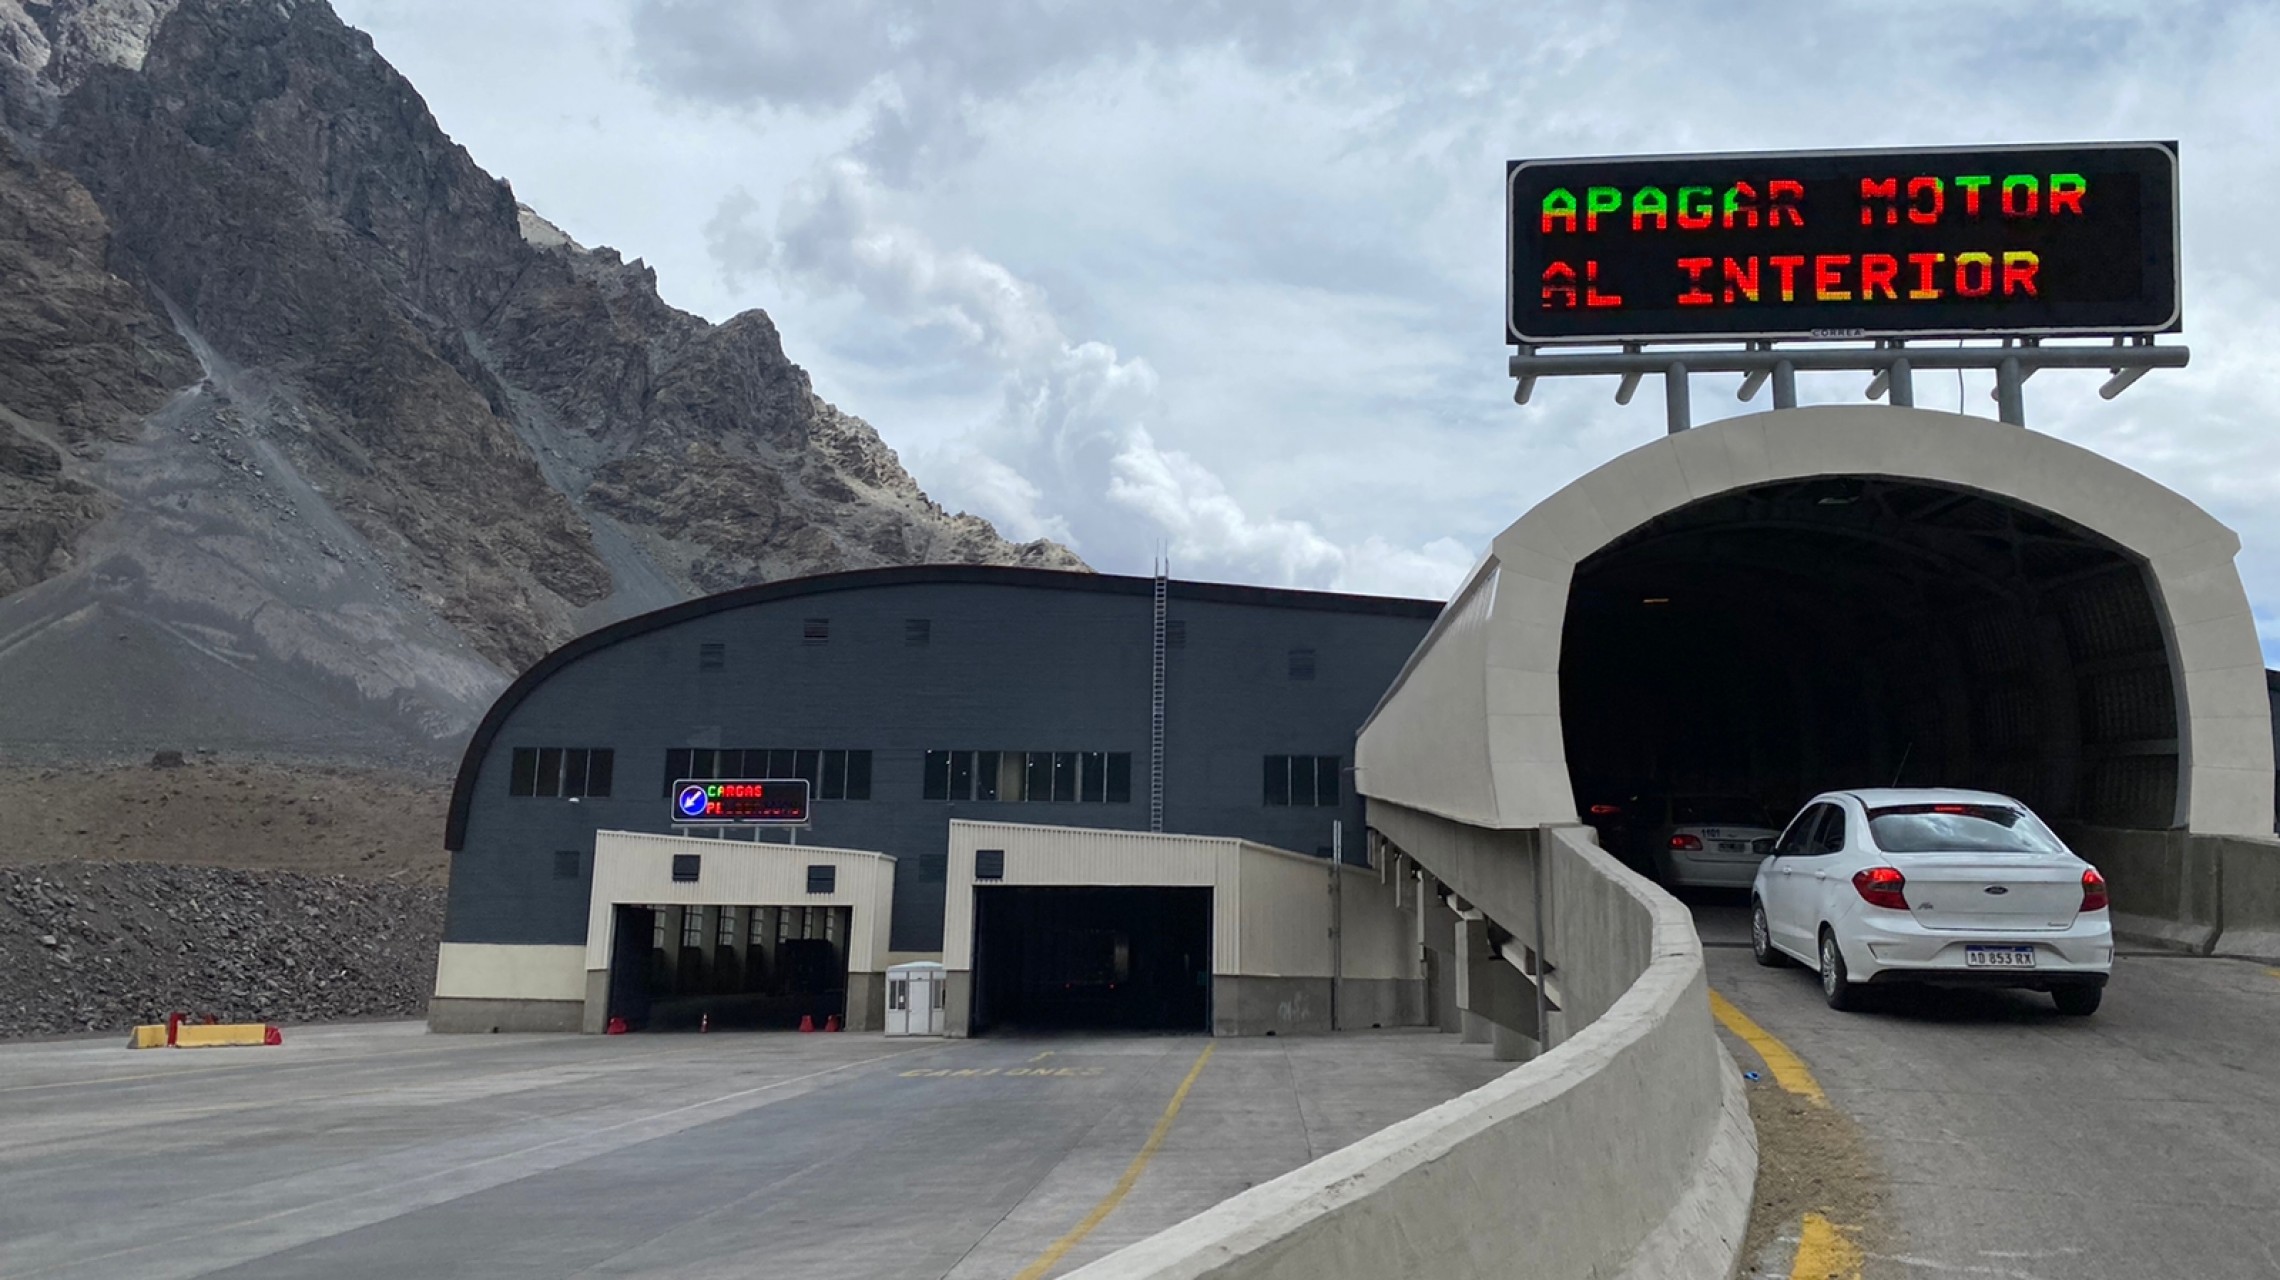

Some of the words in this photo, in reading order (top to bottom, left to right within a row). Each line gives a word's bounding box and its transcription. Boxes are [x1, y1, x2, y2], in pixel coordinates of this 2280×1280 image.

[1542, 181, 1803, 232] APAGAR
[1862, 174, 2085, 224] MOTOR
[1543, 261, 1621, 306] AL
[1678, 252, 2038, 304] INTERIOR
[707, 785, 762, 797] CARGAS
[1970, 952, 1986, 964] AD
[1989, 952, 2012, 964] 853
[2015, 953, 2032, 964] RX
